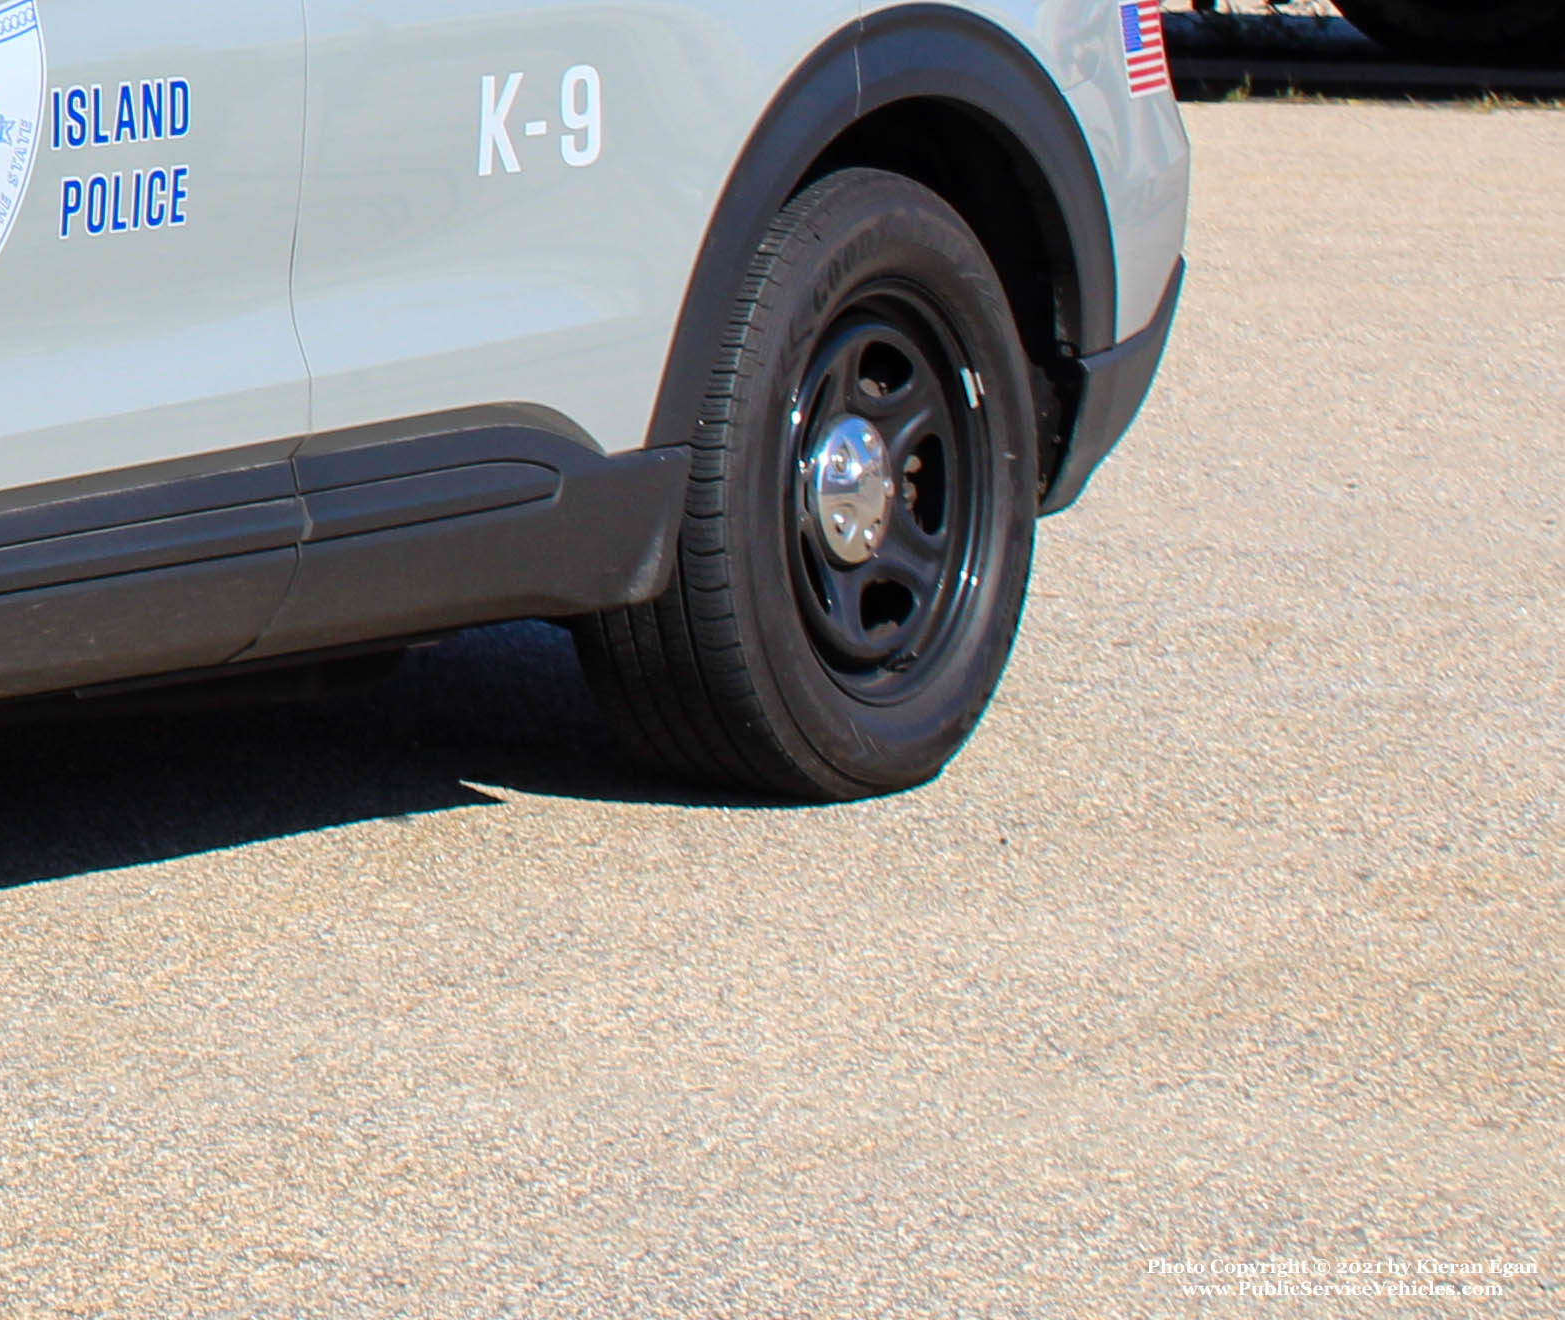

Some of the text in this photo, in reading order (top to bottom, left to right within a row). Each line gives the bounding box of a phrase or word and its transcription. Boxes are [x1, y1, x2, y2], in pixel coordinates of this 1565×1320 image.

[51, 77, 190, 150] ISLAND
[478, 64, 602, 176] K-9
[7, 119, 33, 187] STATE
[58, 164, 189, 239] POLICE
